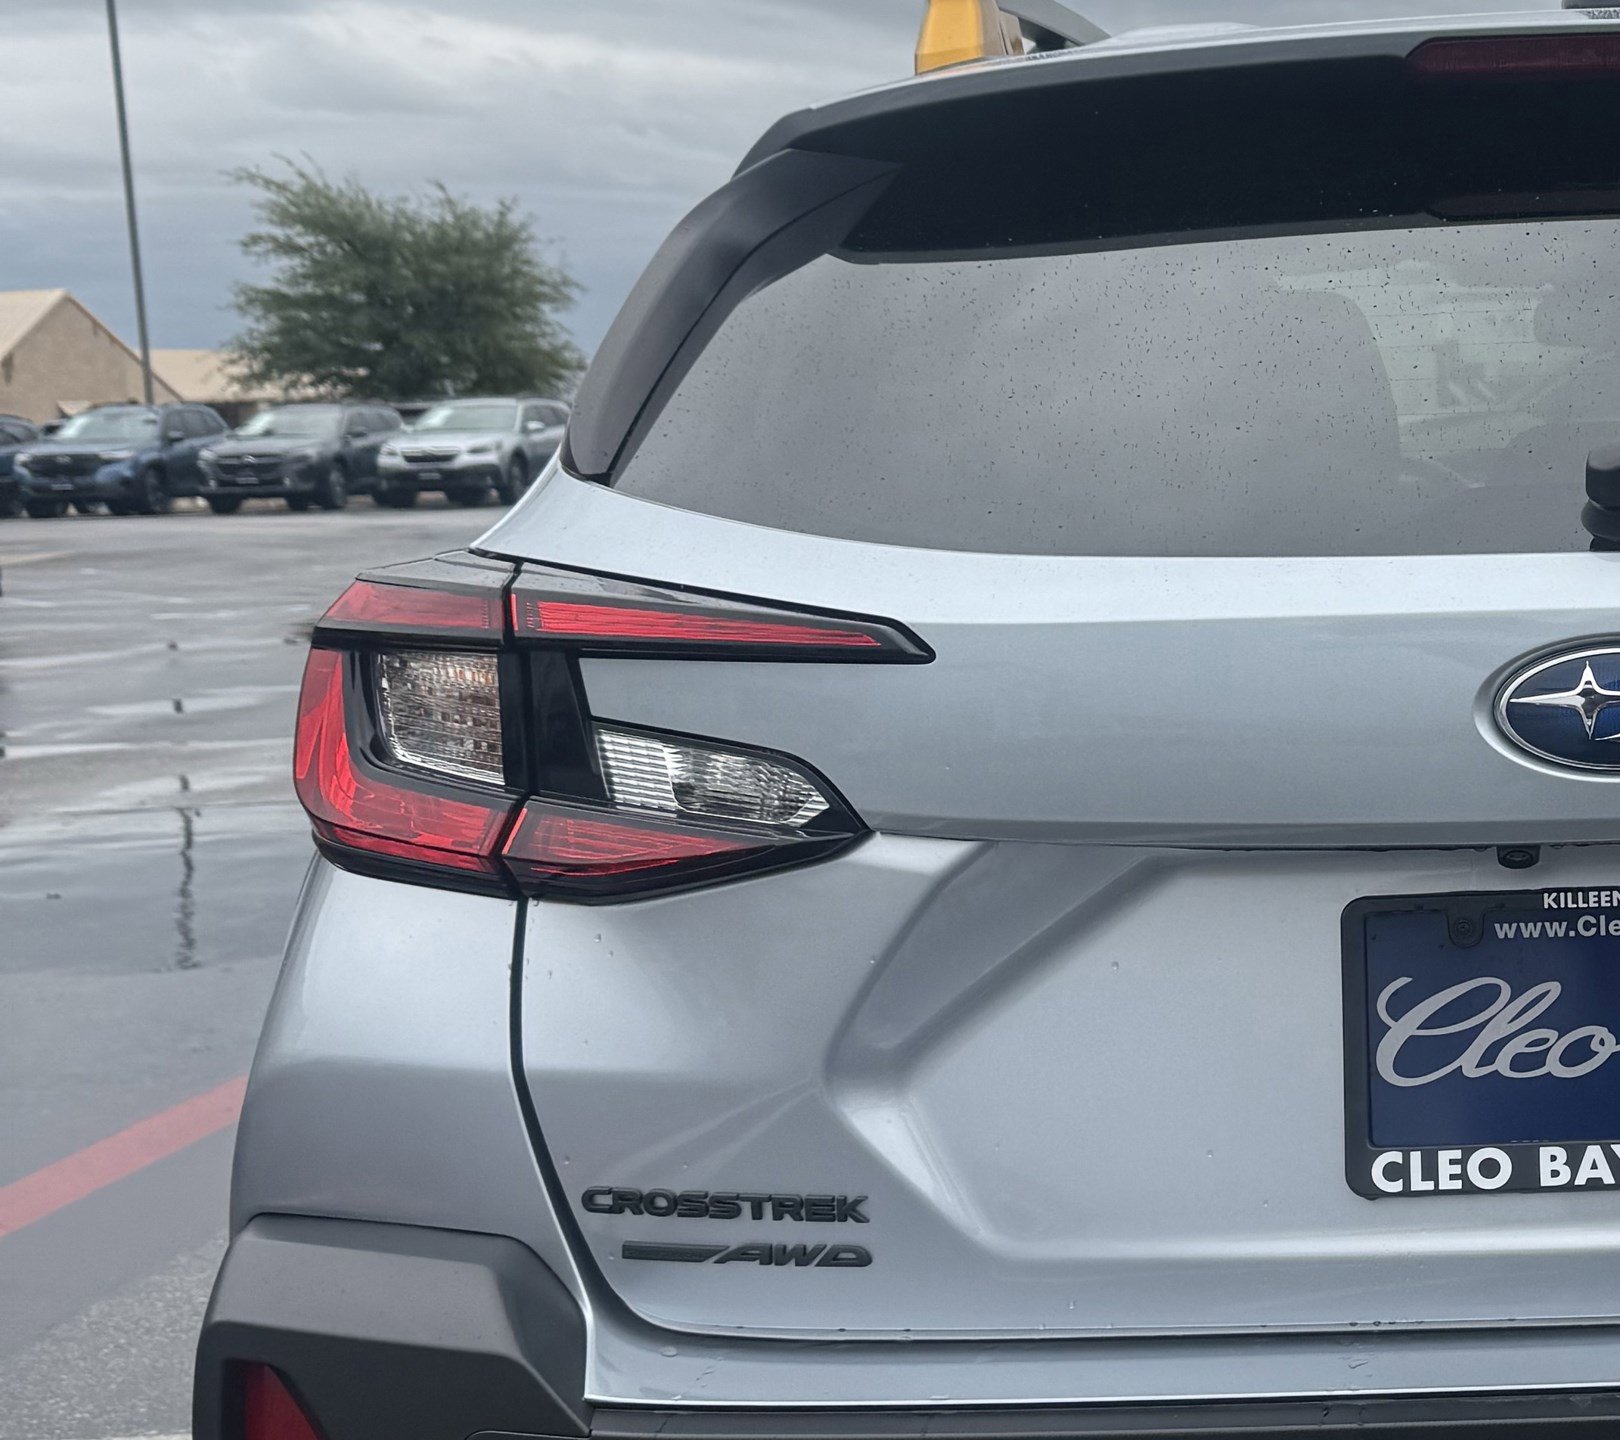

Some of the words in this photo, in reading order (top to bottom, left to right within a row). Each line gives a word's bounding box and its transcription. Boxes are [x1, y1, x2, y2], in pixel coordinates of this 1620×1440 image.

[1370, 1146, 1513, 1194] CLEO
[581, 1185, 871, 1224] CROSSTREK
[713, 1242, 874, 1268] AWD
